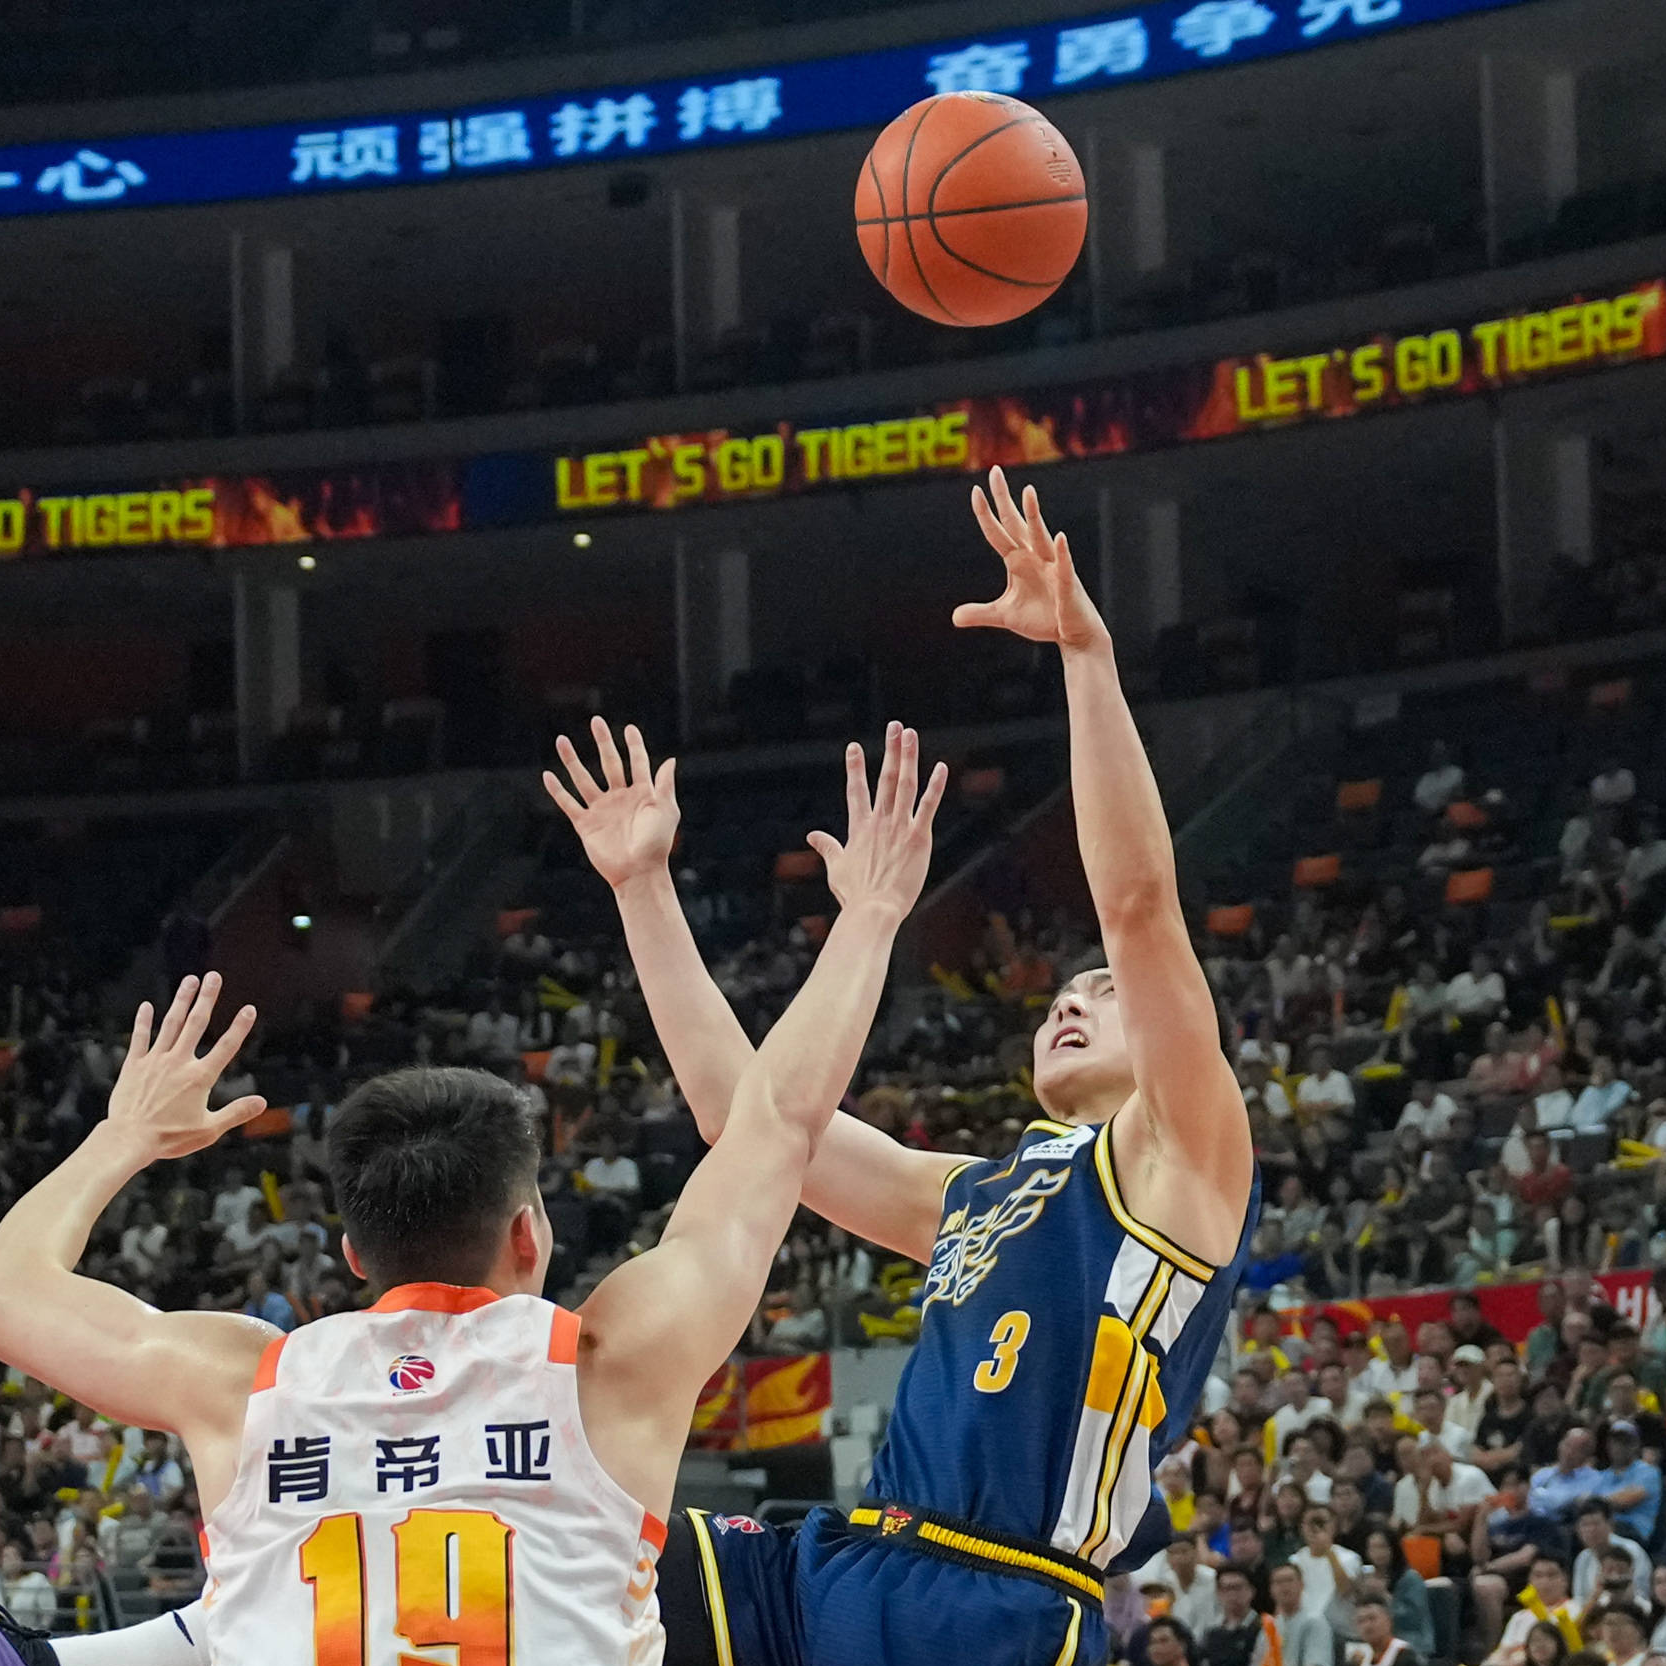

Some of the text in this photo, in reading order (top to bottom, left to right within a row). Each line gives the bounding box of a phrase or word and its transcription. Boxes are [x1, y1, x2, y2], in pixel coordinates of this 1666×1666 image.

[291, 76, 783, 184] 顽强拼搏
[1395, 329, 1462, 393] GO
[1473, 293, 1645, 379] TIGERS
[718, 434, 784, 492] GO
[797, 411, 969, 482] TIGERS
[38, 488, 216, 549] TIGERS
[974, 1310, 1031, 1394] 3
[267, 1418, 552, 1504] 肯帝亚
